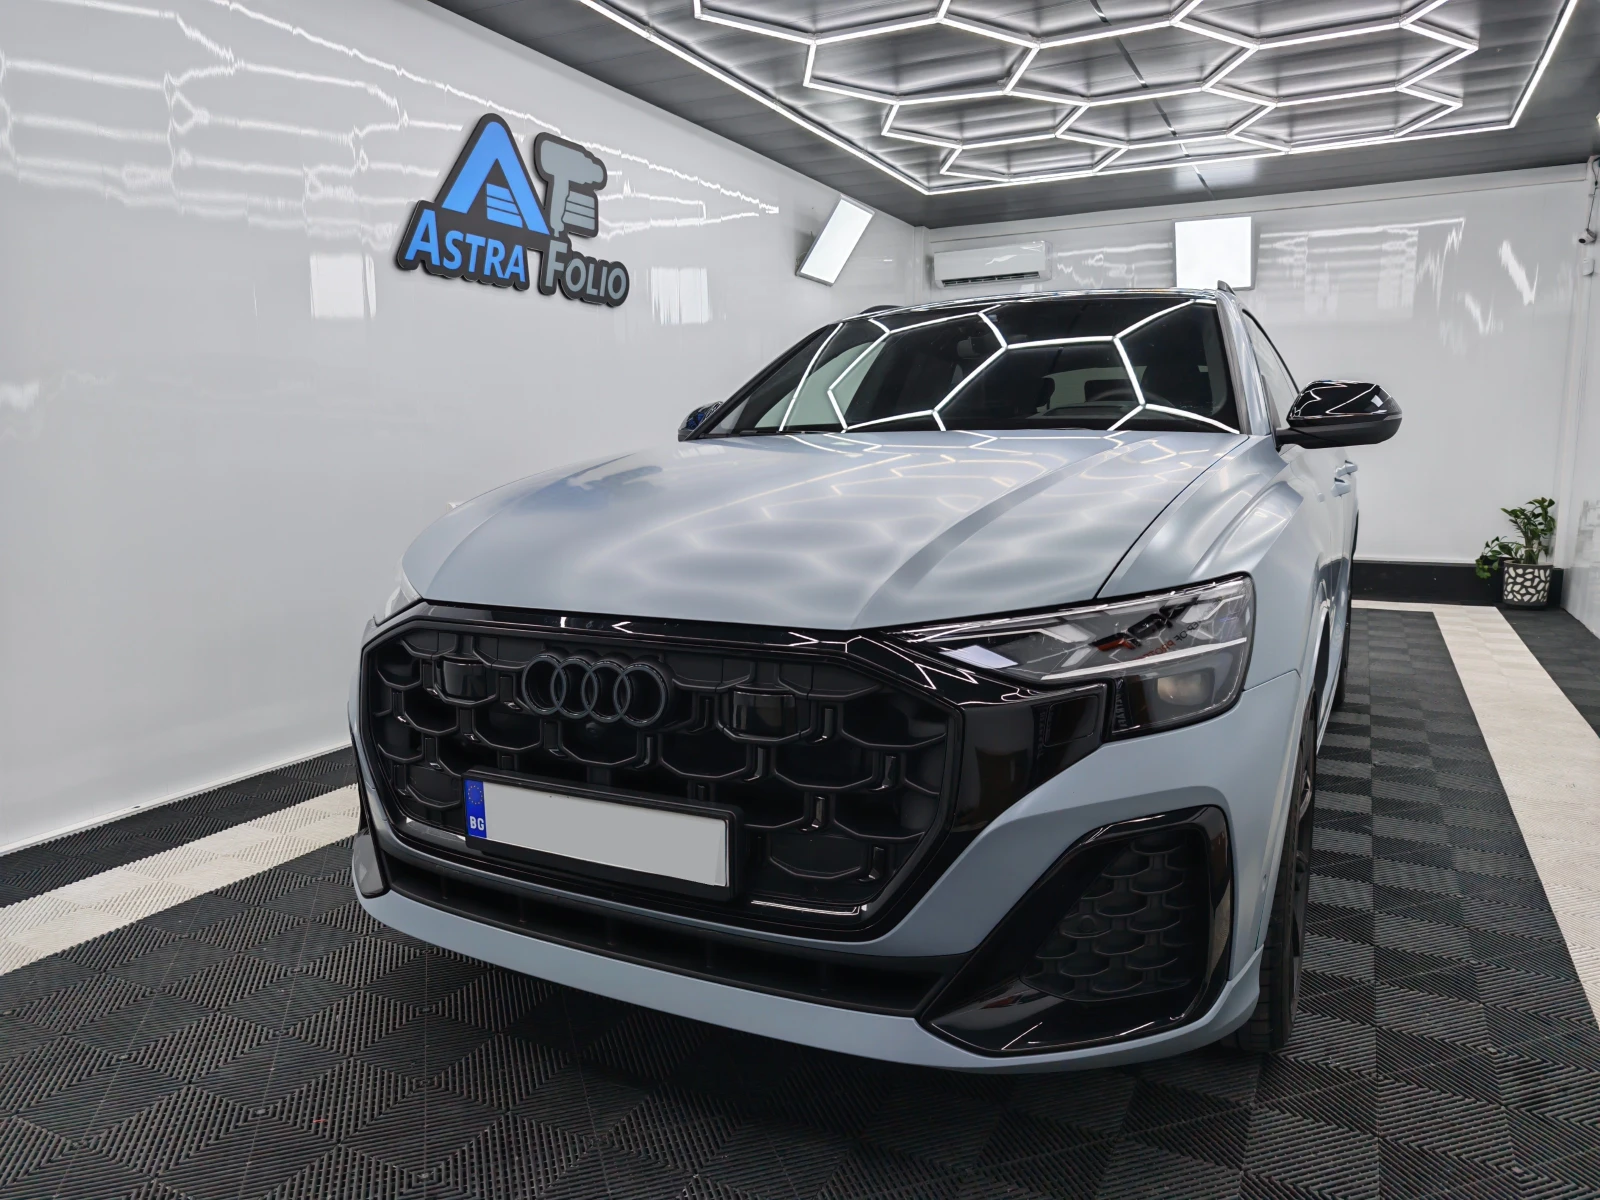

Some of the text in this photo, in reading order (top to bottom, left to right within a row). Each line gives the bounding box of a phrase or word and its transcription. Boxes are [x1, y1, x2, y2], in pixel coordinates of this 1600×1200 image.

[404, 208, 627, 300] ASTRA FOLIO
[469, 815, 485, 831] BG
